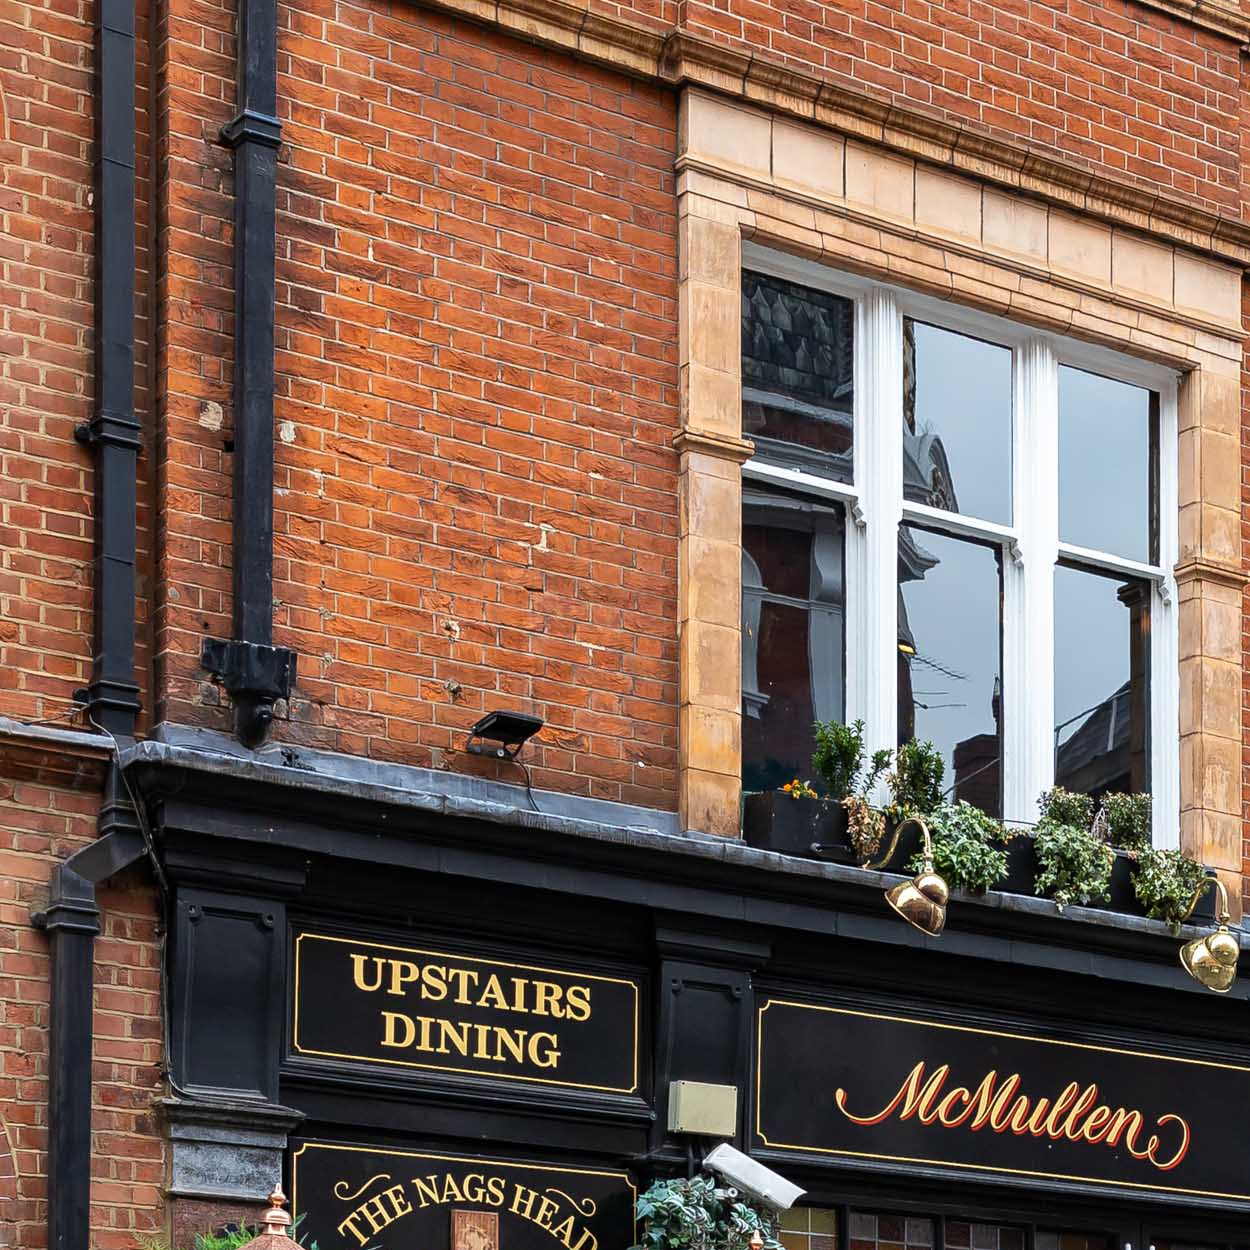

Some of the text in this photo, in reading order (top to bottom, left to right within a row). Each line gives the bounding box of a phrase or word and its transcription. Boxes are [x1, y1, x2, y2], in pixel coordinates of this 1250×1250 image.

[350, 953, 592, 1022] UPSTAIRS
[381, 1011, 561, 1068] DINING
[835, 1060, 1191, 1171] McMullen
[337, 1184, 413, 1248] THE
[411, 1172, 506, 1208] NAGS
